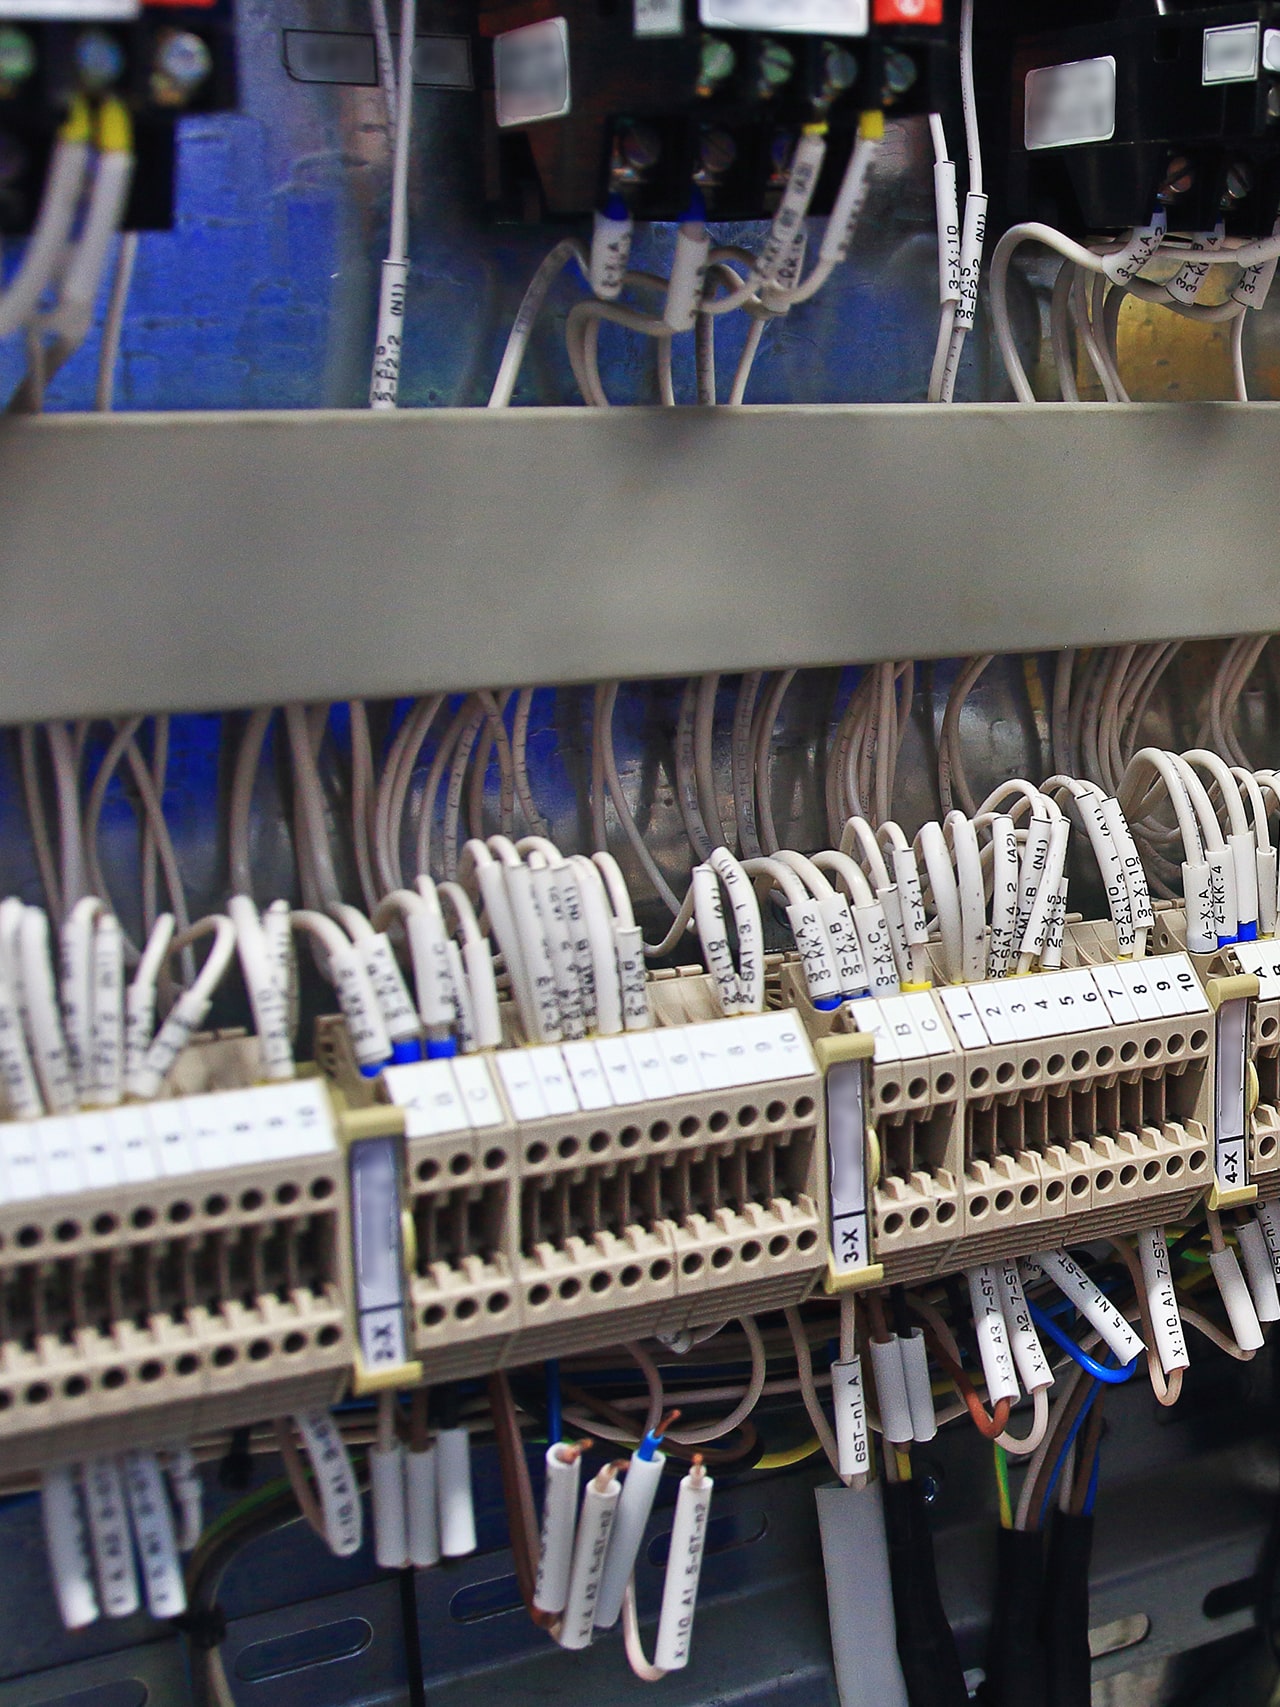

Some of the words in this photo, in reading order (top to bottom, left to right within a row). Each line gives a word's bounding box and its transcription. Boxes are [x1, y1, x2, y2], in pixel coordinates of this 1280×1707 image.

[948, 225, 960, 290] 3-X:10
[1007, 833, 1017, 863] (A2)
[1033, 839, 1047, 870] (N1)
[1199, 889, 1212, 940] 4-X:A
[1213, 865, 1225, 924] 4-KK:4
[830, 923, 854, 978] 3-X:B
[868, 932, 889, 987] 3-X:C
[987, 928, 1003, 977] 3-X:4
[958, 1011, 973, 1021] 1
[986, 1007, 1002, 1017] 2
[1011, 1003, 1026, 1013] 3
[1034, 999, 1049, 1009] 4
[1059, 996, 1075, 1006] 5
[1083, 992, 1098, 1002] 6
[1108, 989, 1124, 999] 7
[1133, 984, 1148, 995] 8
[1156, 981, 1171, 991] 9
[1177, 973, 1195, 992] 10
[895, 1023, 912, 1036] B
[921, 1018, 938, 1031] C
[1224, 1150, 1239, 1184] 4-X
[842, 1227, 860, 1264] 3-X
